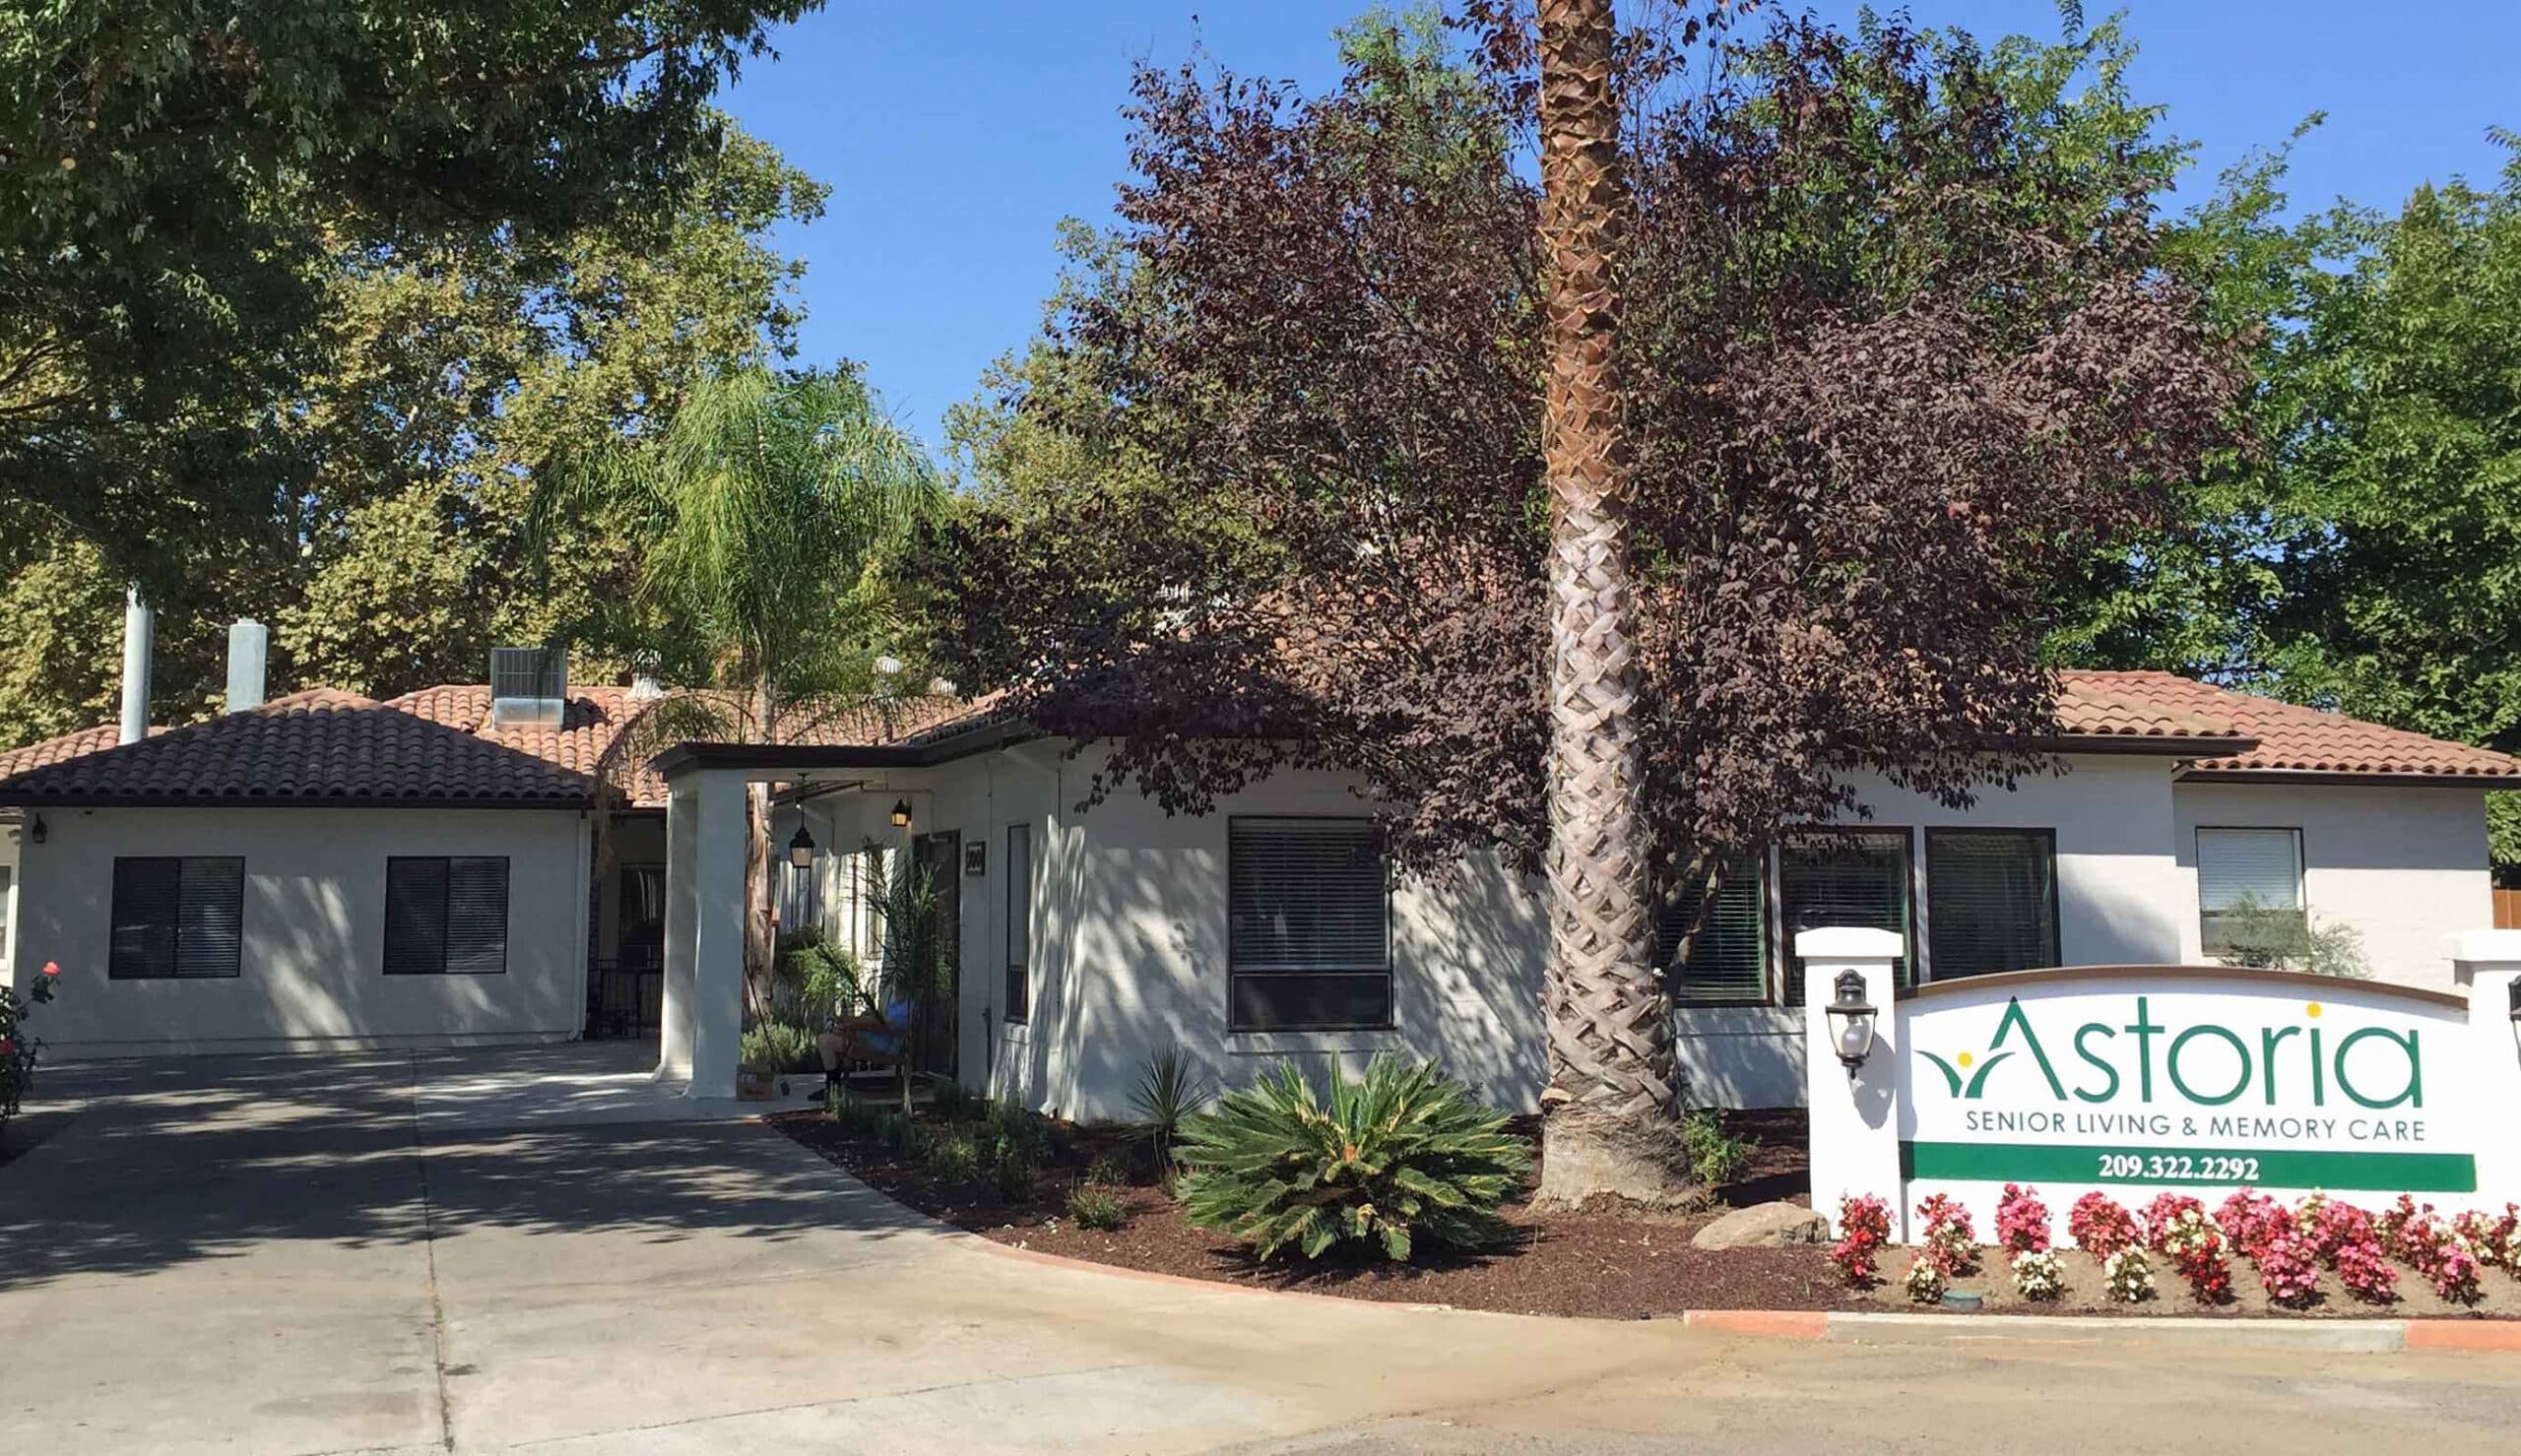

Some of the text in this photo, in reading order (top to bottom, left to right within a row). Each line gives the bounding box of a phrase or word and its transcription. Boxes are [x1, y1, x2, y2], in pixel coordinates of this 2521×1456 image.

[1989, 995, 2424, 1108] Astoria
[1967, 1110, 2424, 1141] SENIOR LIVING & MEMORY CARE
[2099, 1154, 2259, 1180] 209.322.2292
